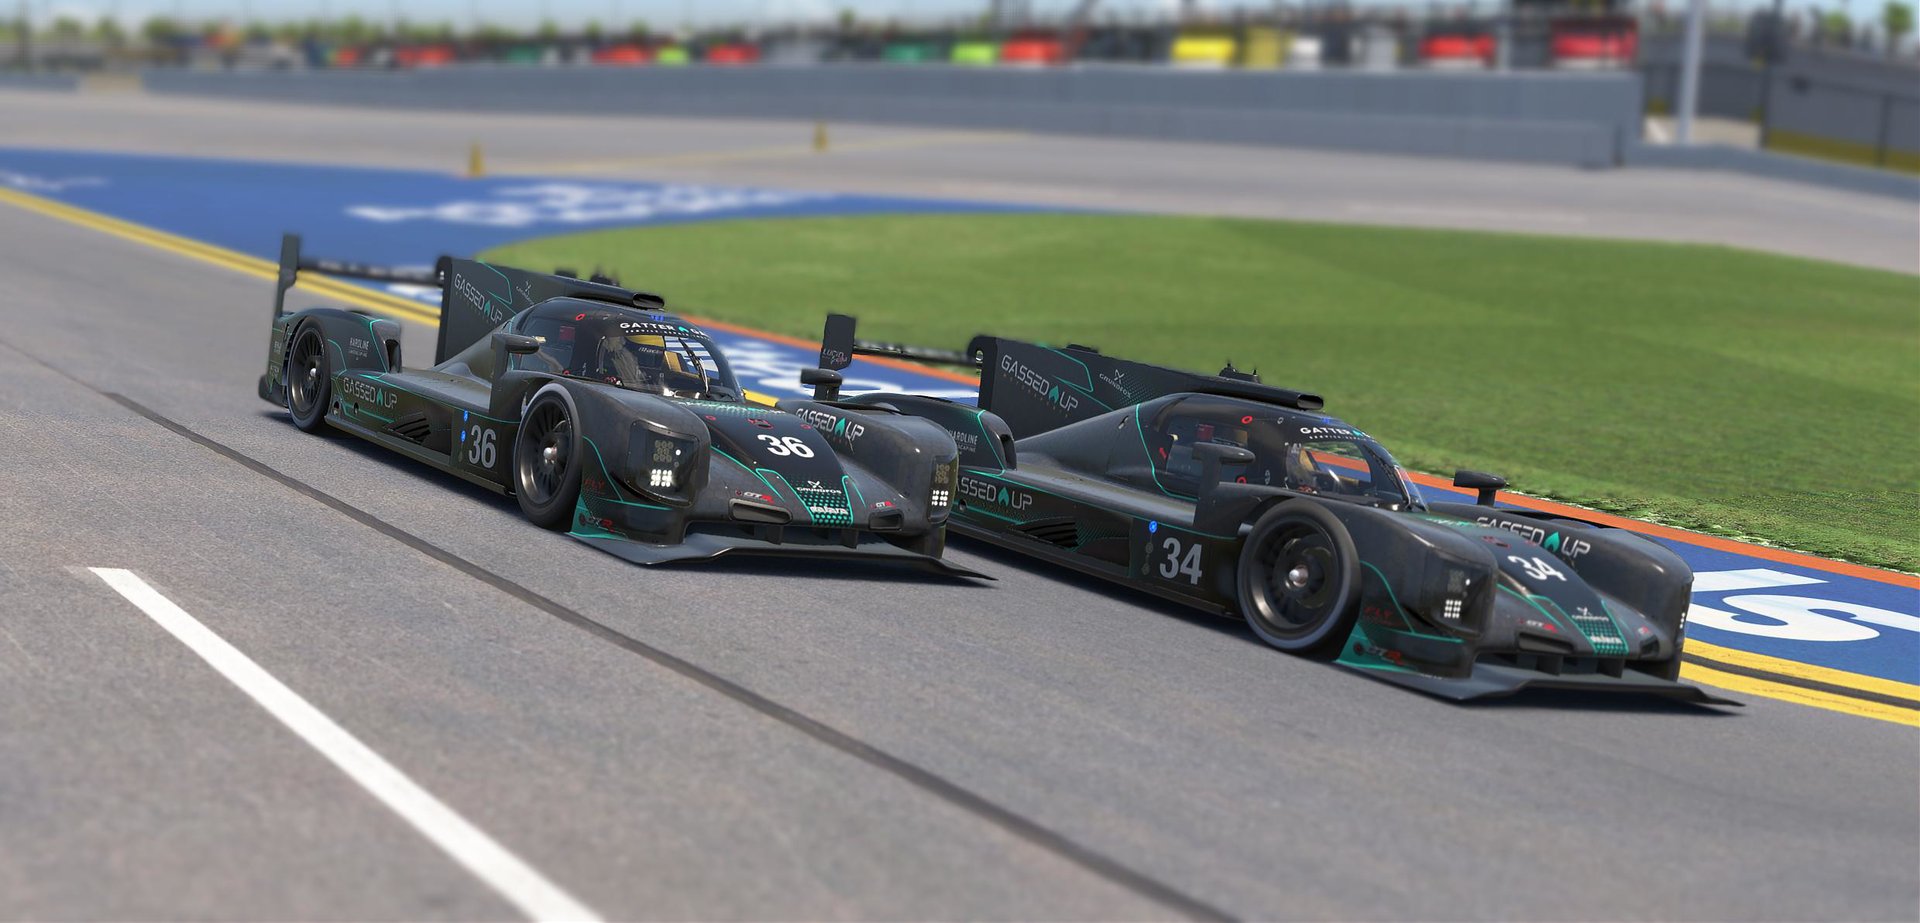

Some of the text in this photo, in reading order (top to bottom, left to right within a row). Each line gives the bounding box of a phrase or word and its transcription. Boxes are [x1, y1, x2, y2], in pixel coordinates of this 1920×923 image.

[454, 273, 485, 311] GASSED
[490, 305, 503, 323] UP
[620, 322, 676, 331] GATTER
[343, 377, 398, 409] GASSED UP
[1001, 354, 1050, 396] GASSED
[1060, 391, 1079, 411] UP
[845, 421, 865, 441] UP
[468, 424, 497, 469] 36
[757, 434, 815, 458] 36
[1011, 490, 1033, 510] UP
[1561, 536, 1591, 558] UP
[1159, 536, 1203, 585] 34
[1507, 555, 1568, 581] 34
